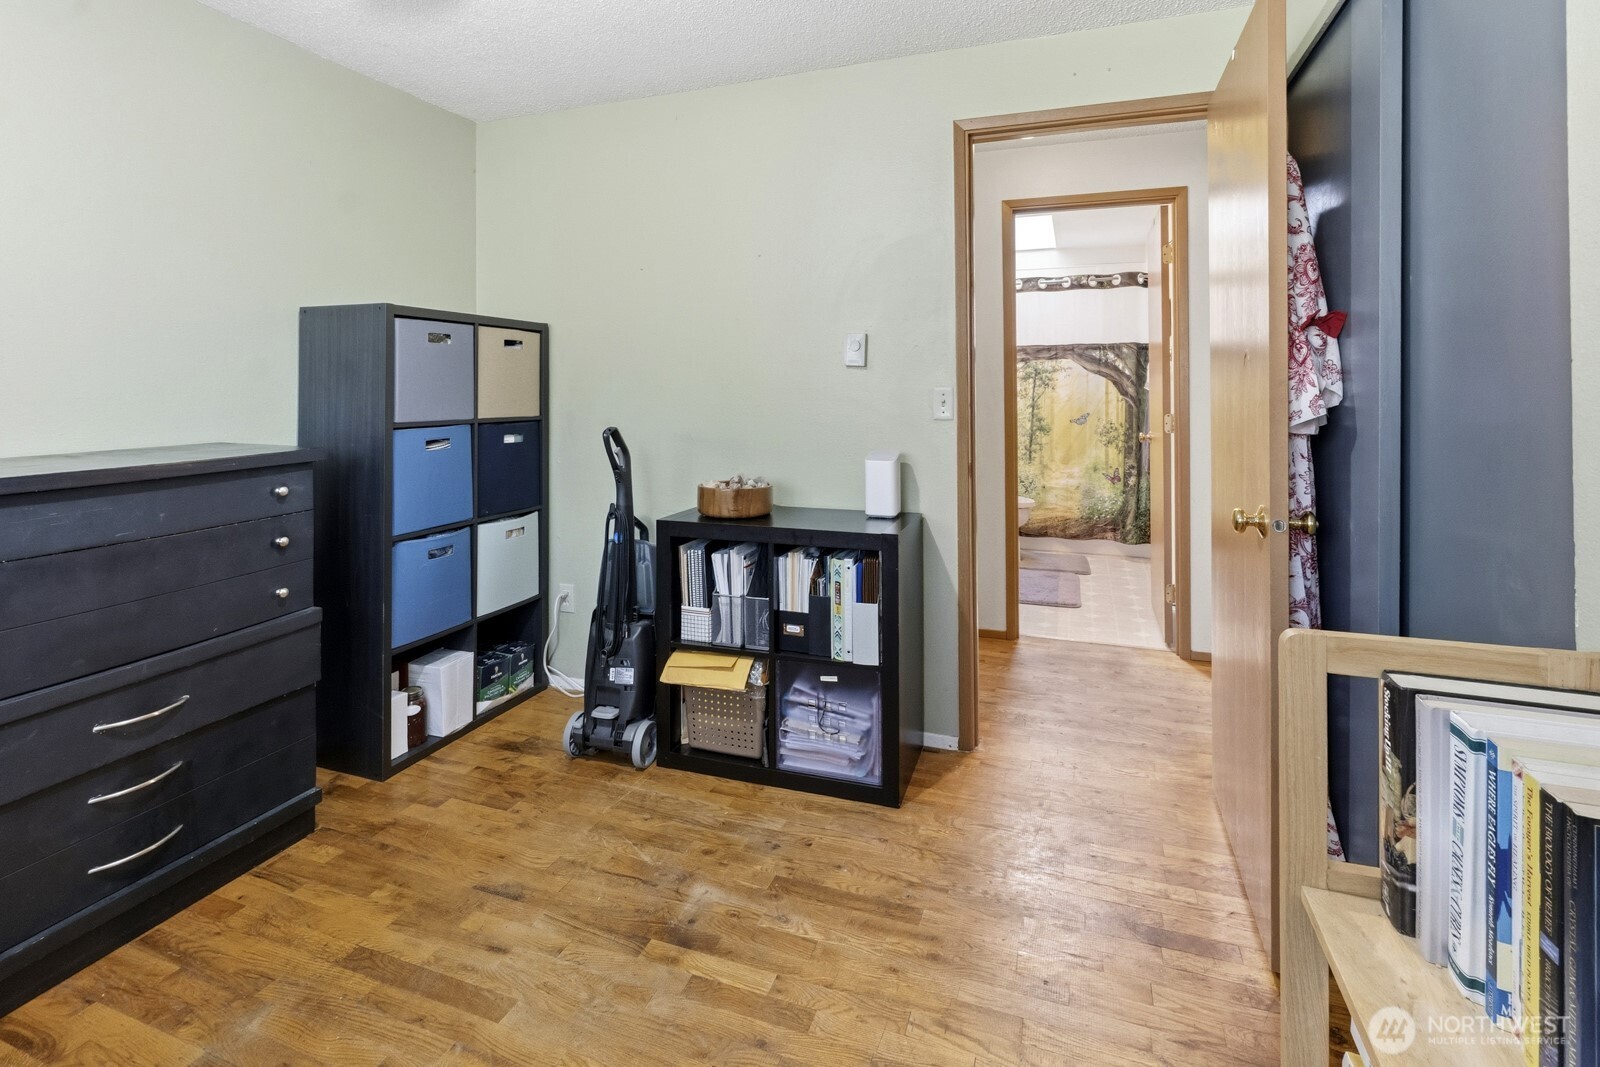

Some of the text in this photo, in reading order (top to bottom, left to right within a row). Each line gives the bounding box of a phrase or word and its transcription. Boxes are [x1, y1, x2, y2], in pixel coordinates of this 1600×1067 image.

[1383, 687, 1391, 742] Stocking
[1384, 737, 1392, 757] Up
[1453, 744, 1467, 824] SYMPTOMS
[1488, 770, 1497, 815] WHERE
[1526, 787, 1534, 807] The
[1525, 809, 1533, 861] Forager's
[1545, 801, 1553, 827] THE
[1487, 813, 1496, 864] EAGLES
[1544, 826, 1553, 880] BIOLOGY
[1451, 840, 1464, 899] CAUSES
[1487, 861, 1496, 888] FLY
[1525, 864, 1533, 909] Harvest
[1544, 877, 1553, 899] OF
[1450, 896, 1462, 946] CURES
[1544, 896, 1553, 936] BELIEF
